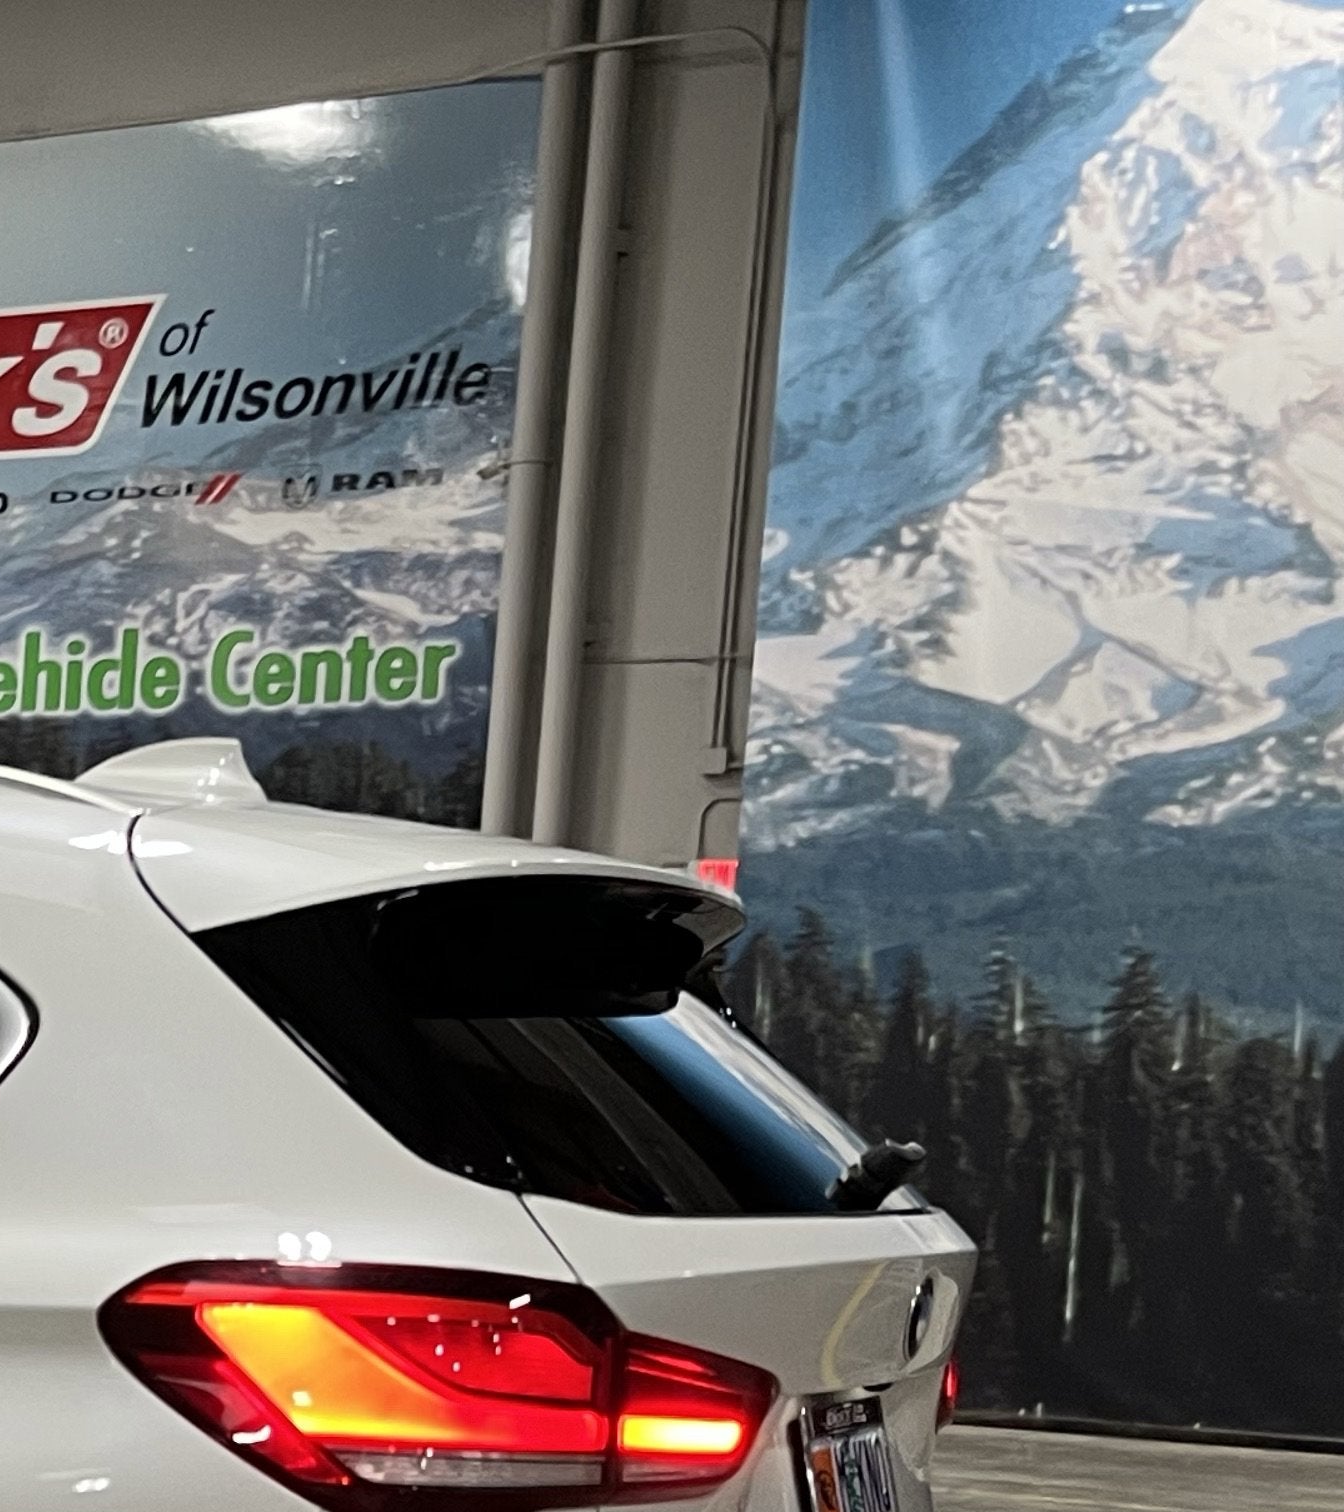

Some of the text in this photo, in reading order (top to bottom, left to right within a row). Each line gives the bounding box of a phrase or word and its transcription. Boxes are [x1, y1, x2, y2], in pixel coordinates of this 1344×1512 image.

[158, 309, 216, 358] of
[140, 342, 492, 429] Wilsonville
[331, 468, 445, 492] RAM
[211, 630, 458, 706] Center
